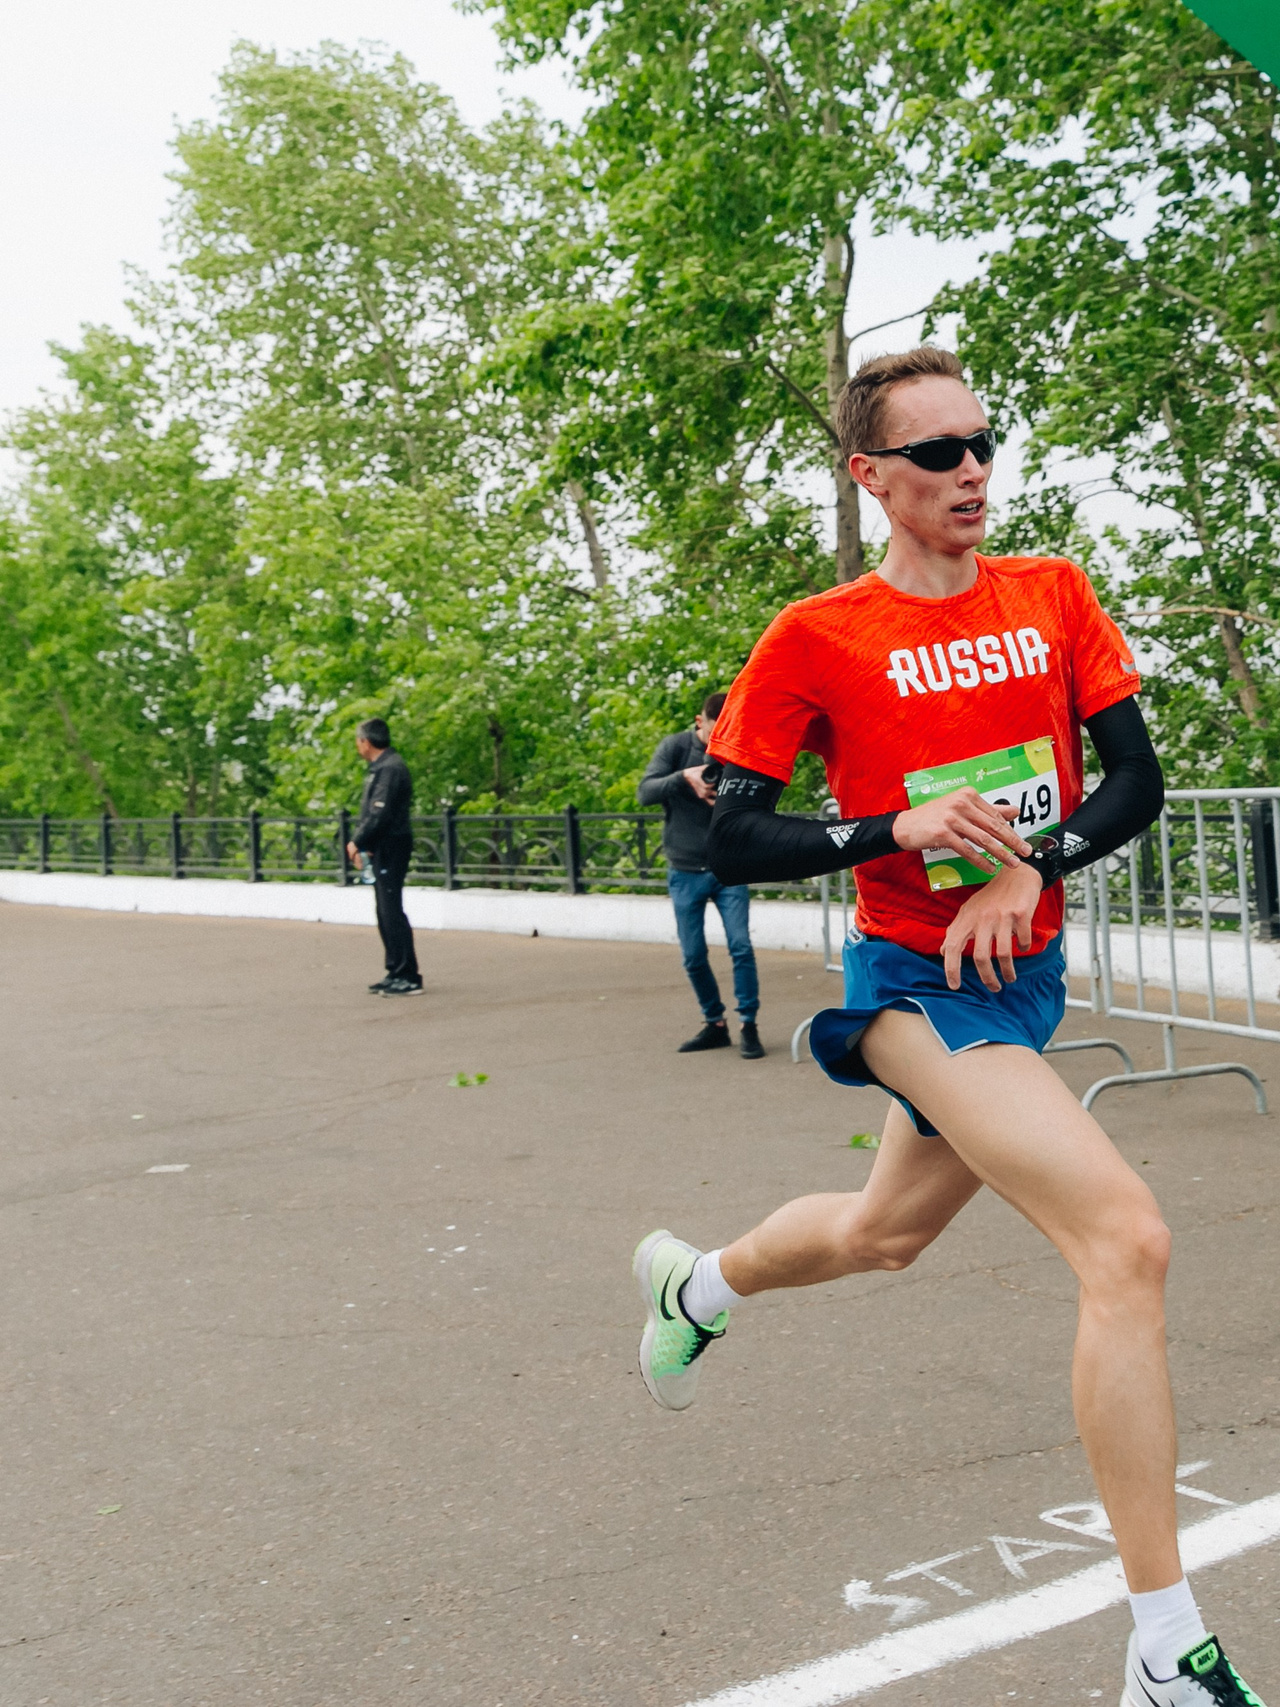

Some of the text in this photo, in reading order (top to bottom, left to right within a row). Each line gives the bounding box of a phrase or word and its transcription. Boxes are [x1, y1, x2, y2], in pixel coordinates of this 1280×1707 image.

[887, 627, 1050, 697] RUSSIA
[826, 821, 860, 834] adidas
[1063, 840, 1091, 858] adidas
